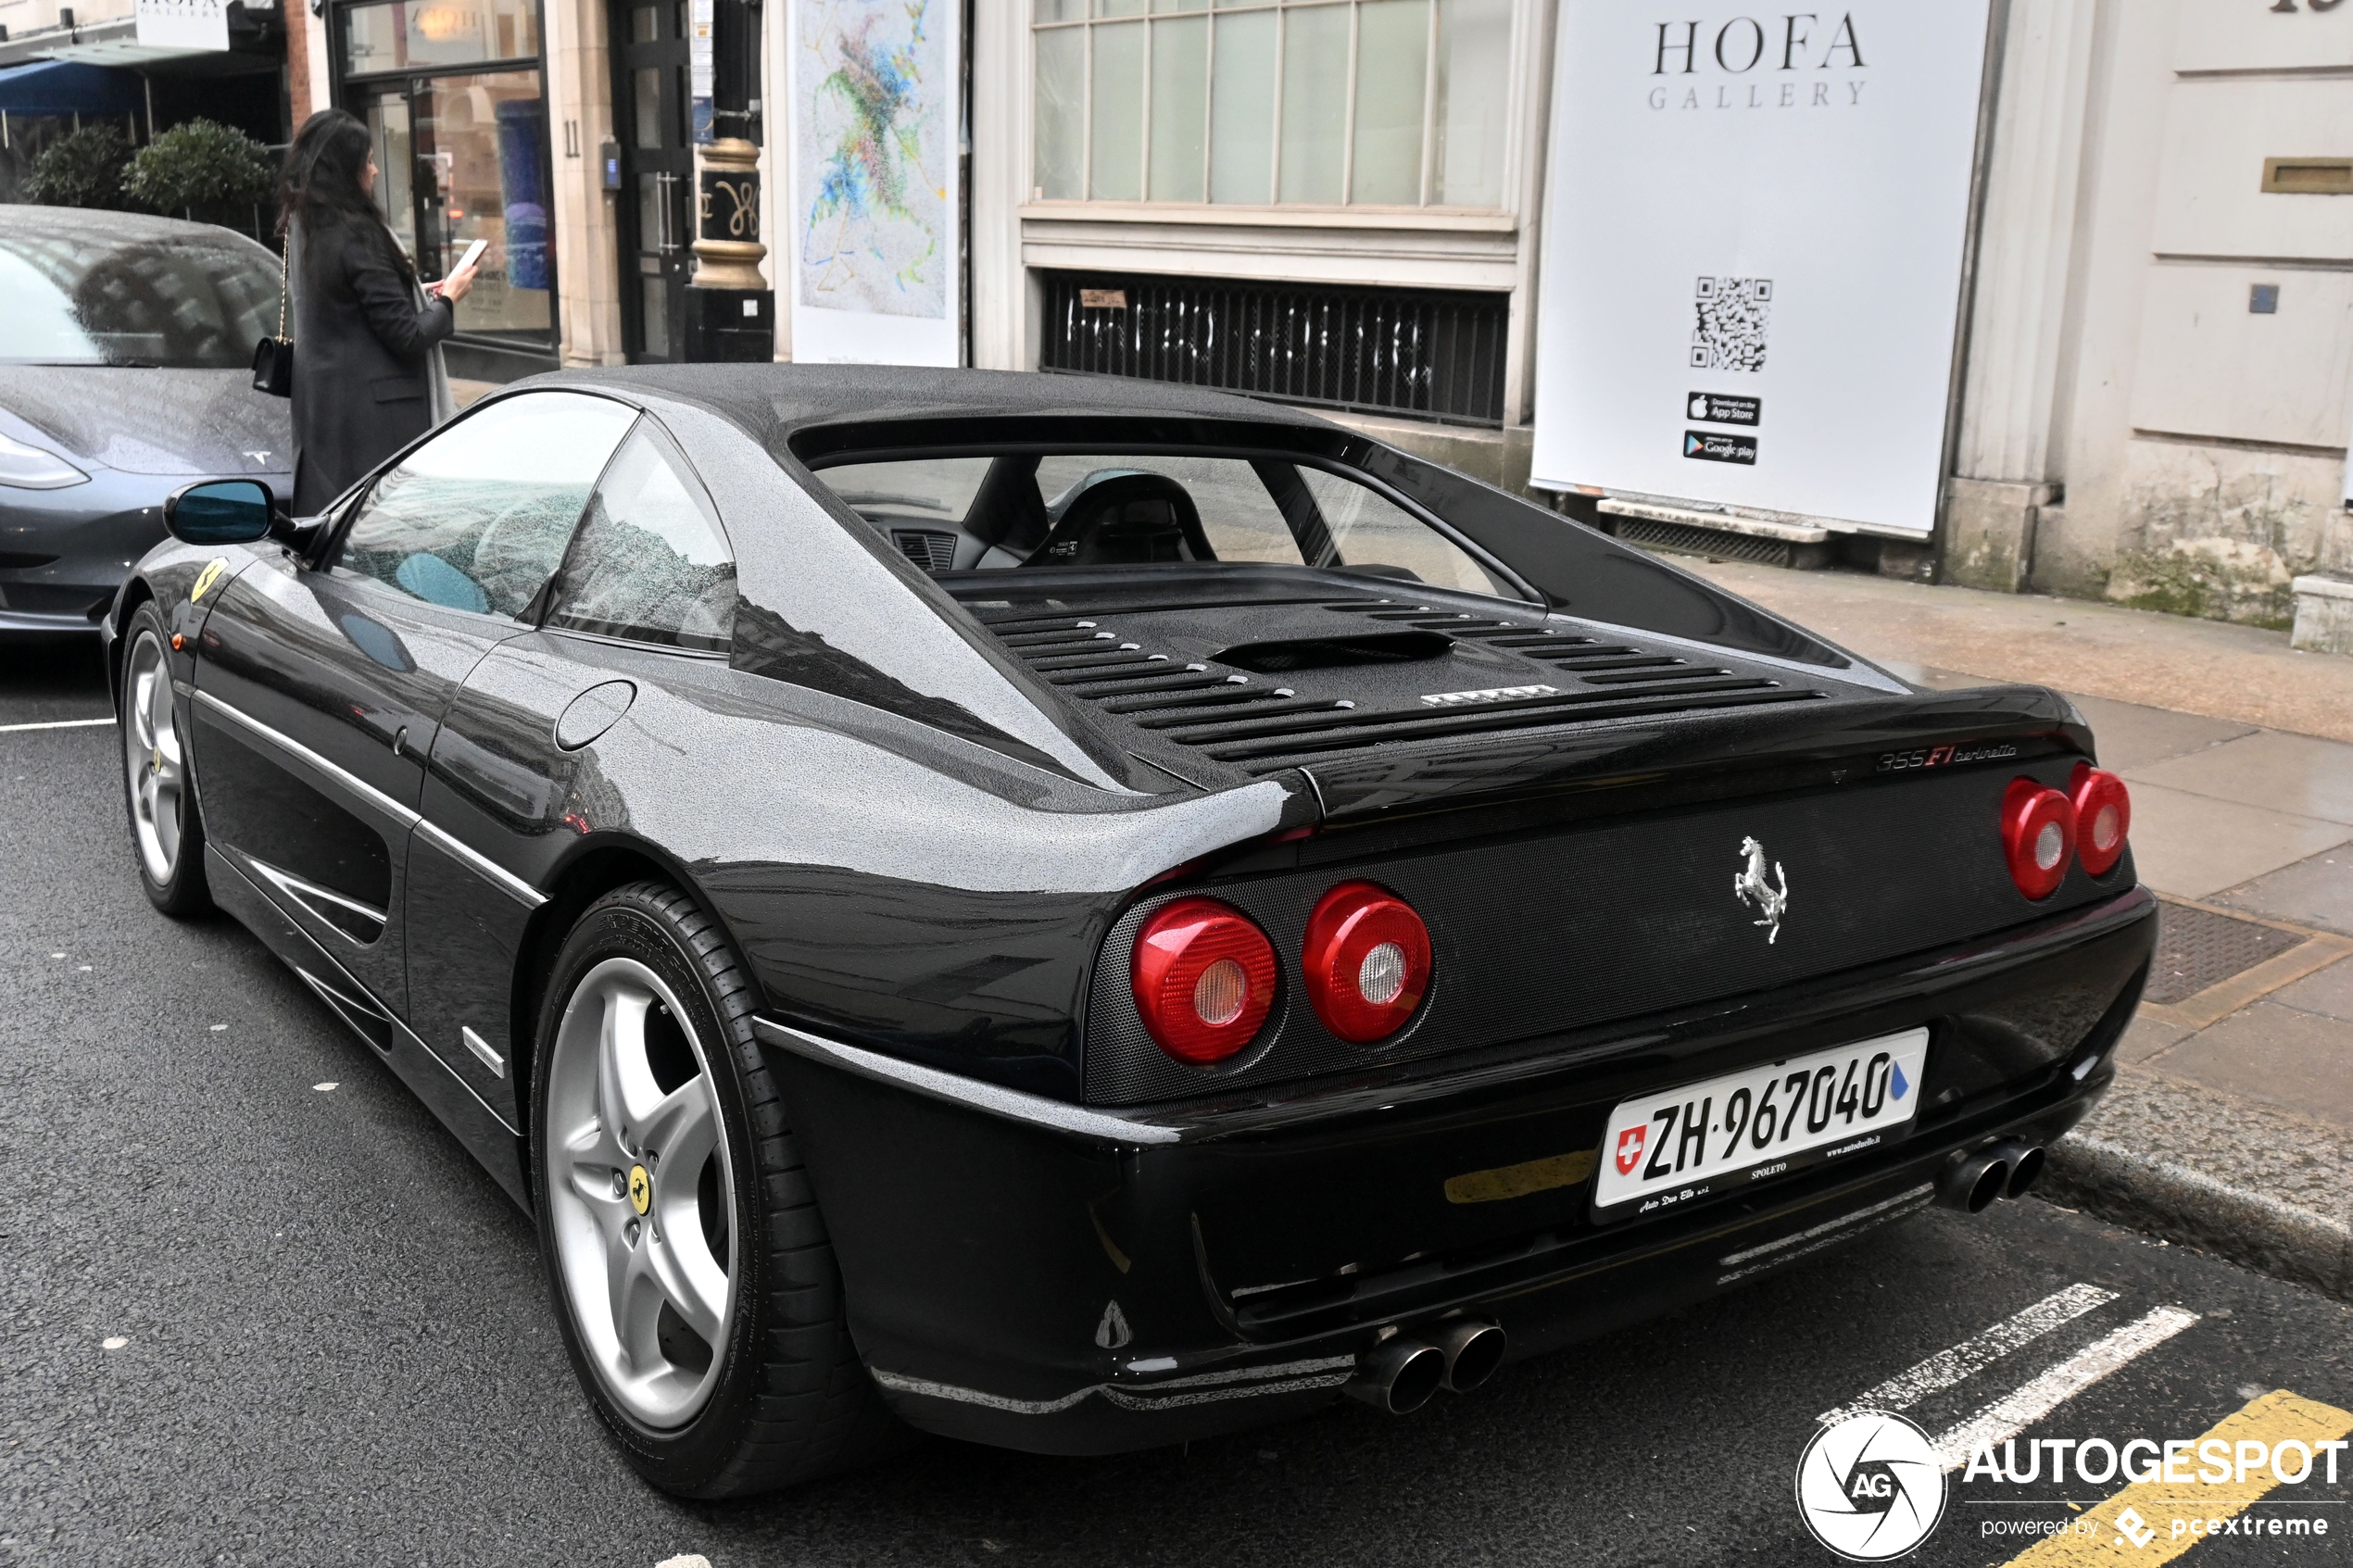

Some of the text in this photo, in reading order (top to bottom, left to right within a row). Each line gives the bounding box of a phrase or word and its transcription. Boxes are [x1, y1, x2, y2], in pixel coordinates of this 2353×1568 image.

[1650, 10, 1870, 75] HOFA
[1649, 81, 1867, 110] GALLERY
[1712, 397, 1738, 408] Download
[1712, 406, 1754, 420] App Store
[1705, 441, 1755, 459] Google play
[1876, 745, 2017, 771] 355 F1 berlinetta
[1826, 1135, 1881, 1158] www.autoduelle.it
[1751, 1162, 1787, 1180] SPOLETO
[1639, 1199, 1659, 1213] Auto
[1661, 1195, 1678, 1207] Due
[1680, 1188, 1694, 1201] Elle
